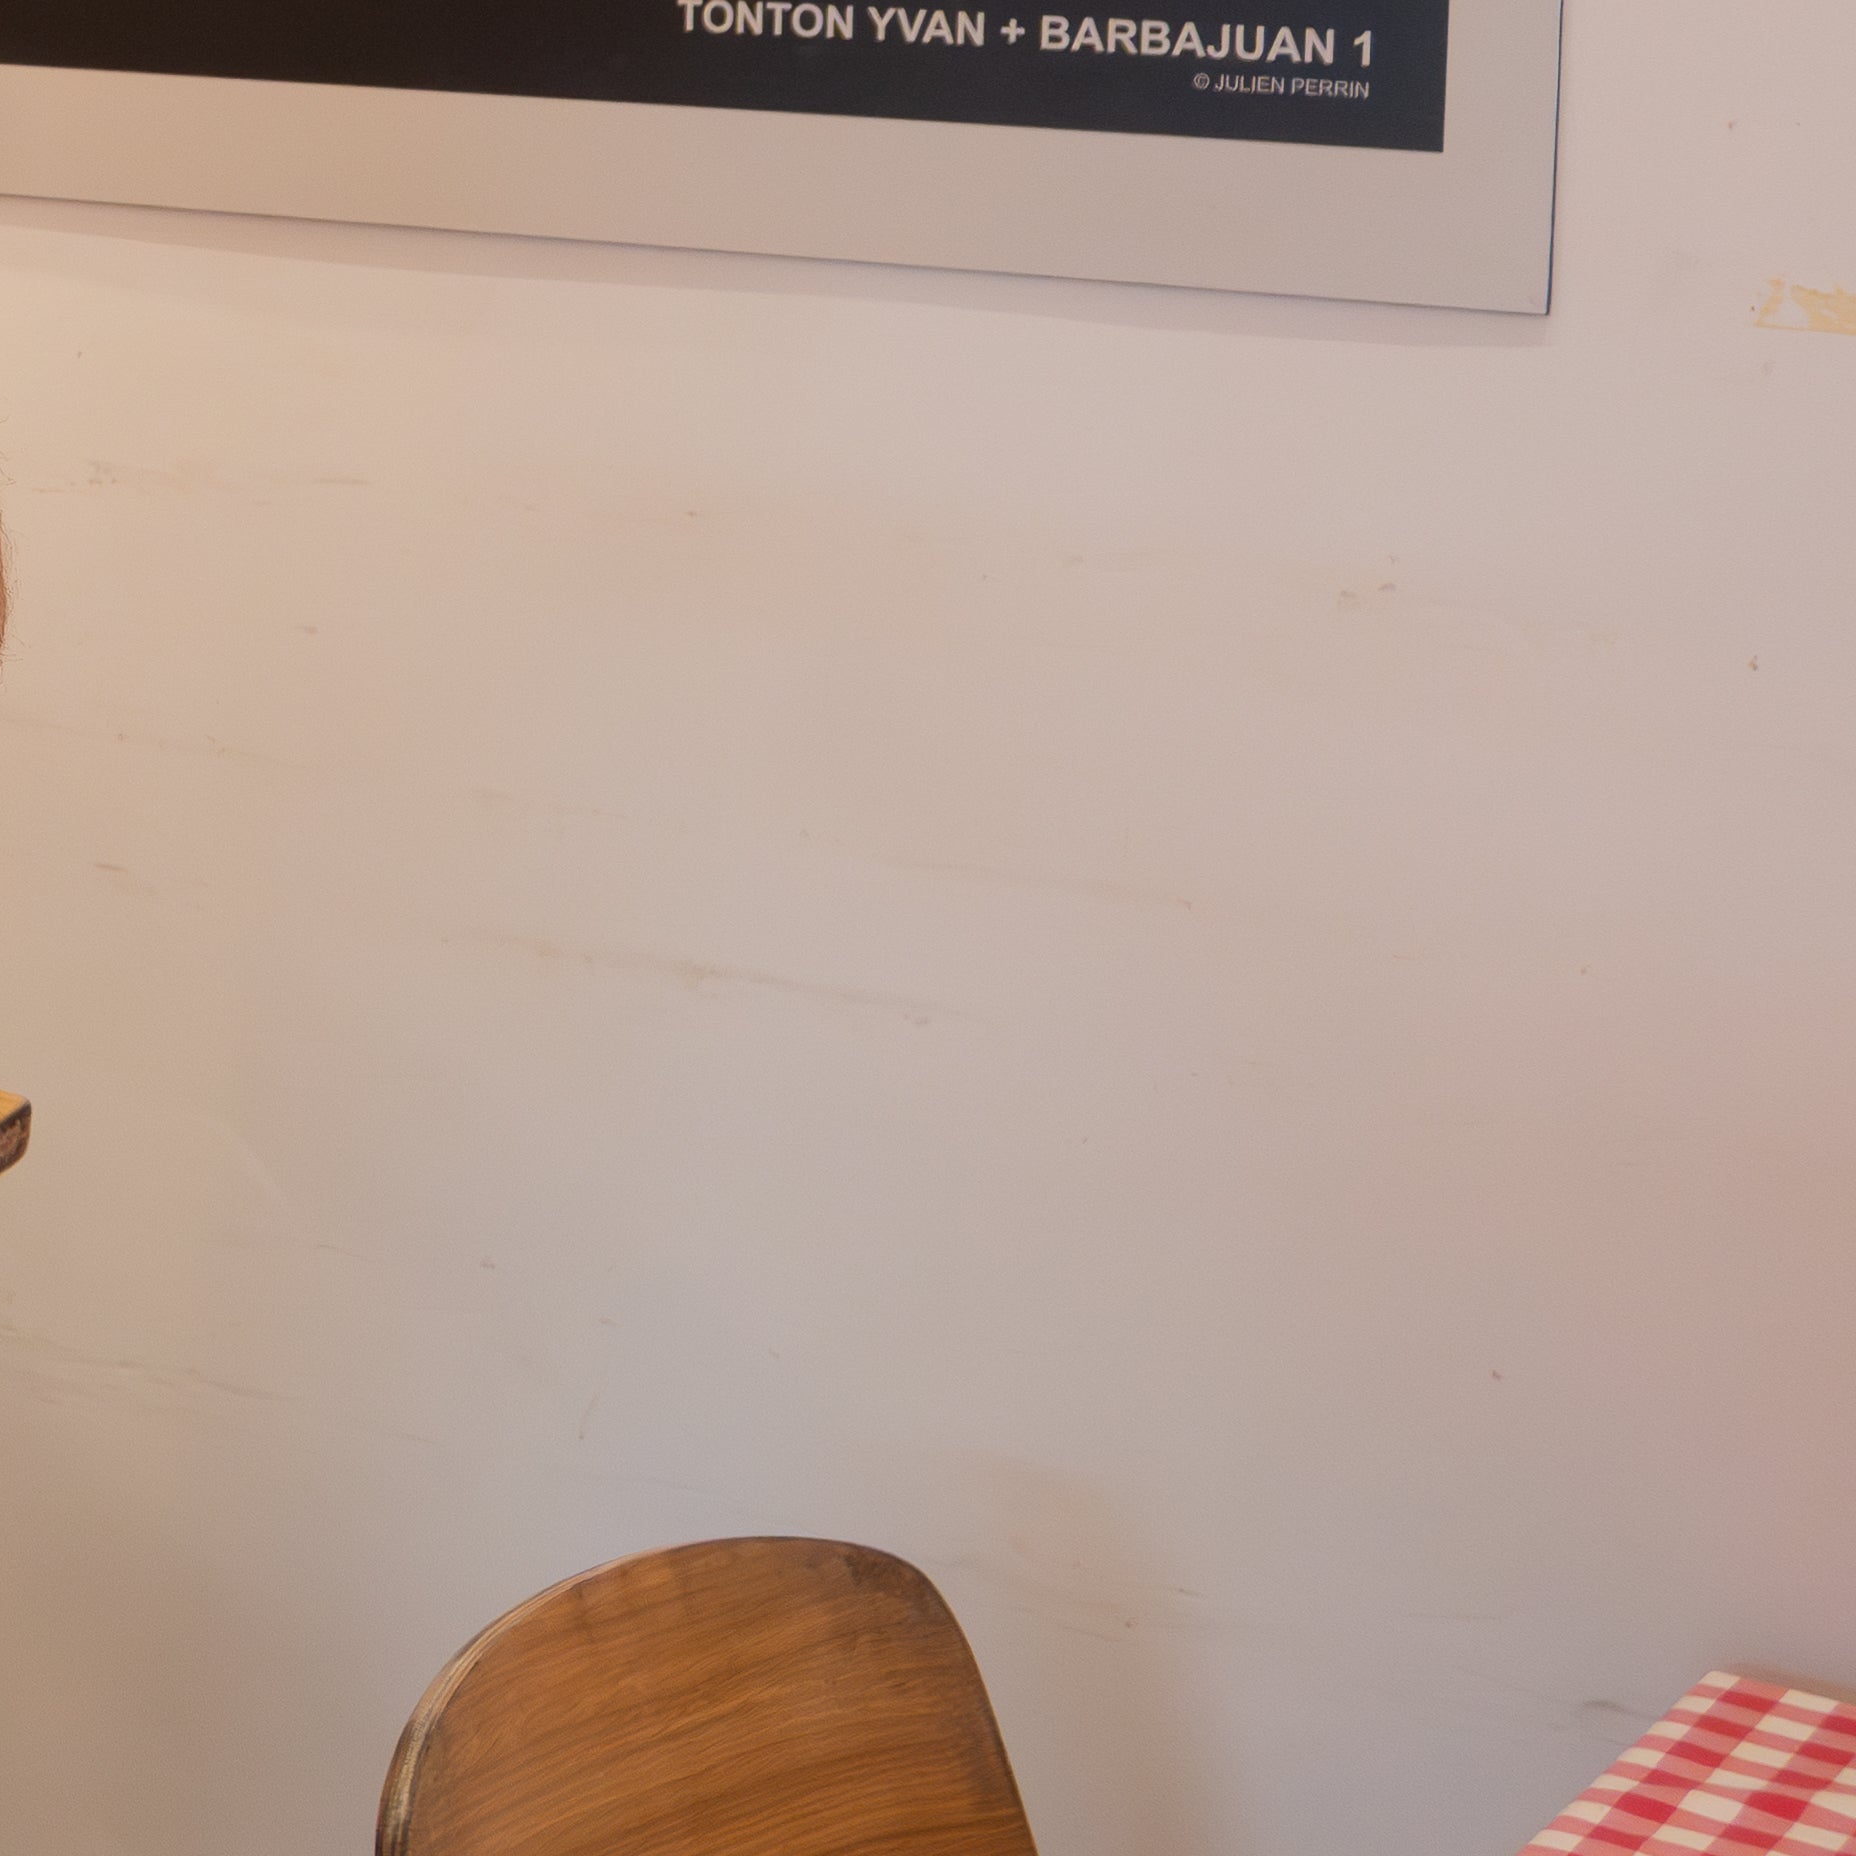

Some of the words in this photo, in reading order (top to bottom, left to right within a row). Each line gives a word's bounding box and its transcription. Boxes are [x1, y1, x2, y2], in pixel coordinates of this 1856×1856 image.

[867, 5, 986, 47] YVAN
[1039, 14, 1336, 66] BARBAJUAN
[1352, 29, 1373, 68] 1
[1214, 73, 1285, 96] JULIEN
[1291, 77, 1370, 100] PERRIN
